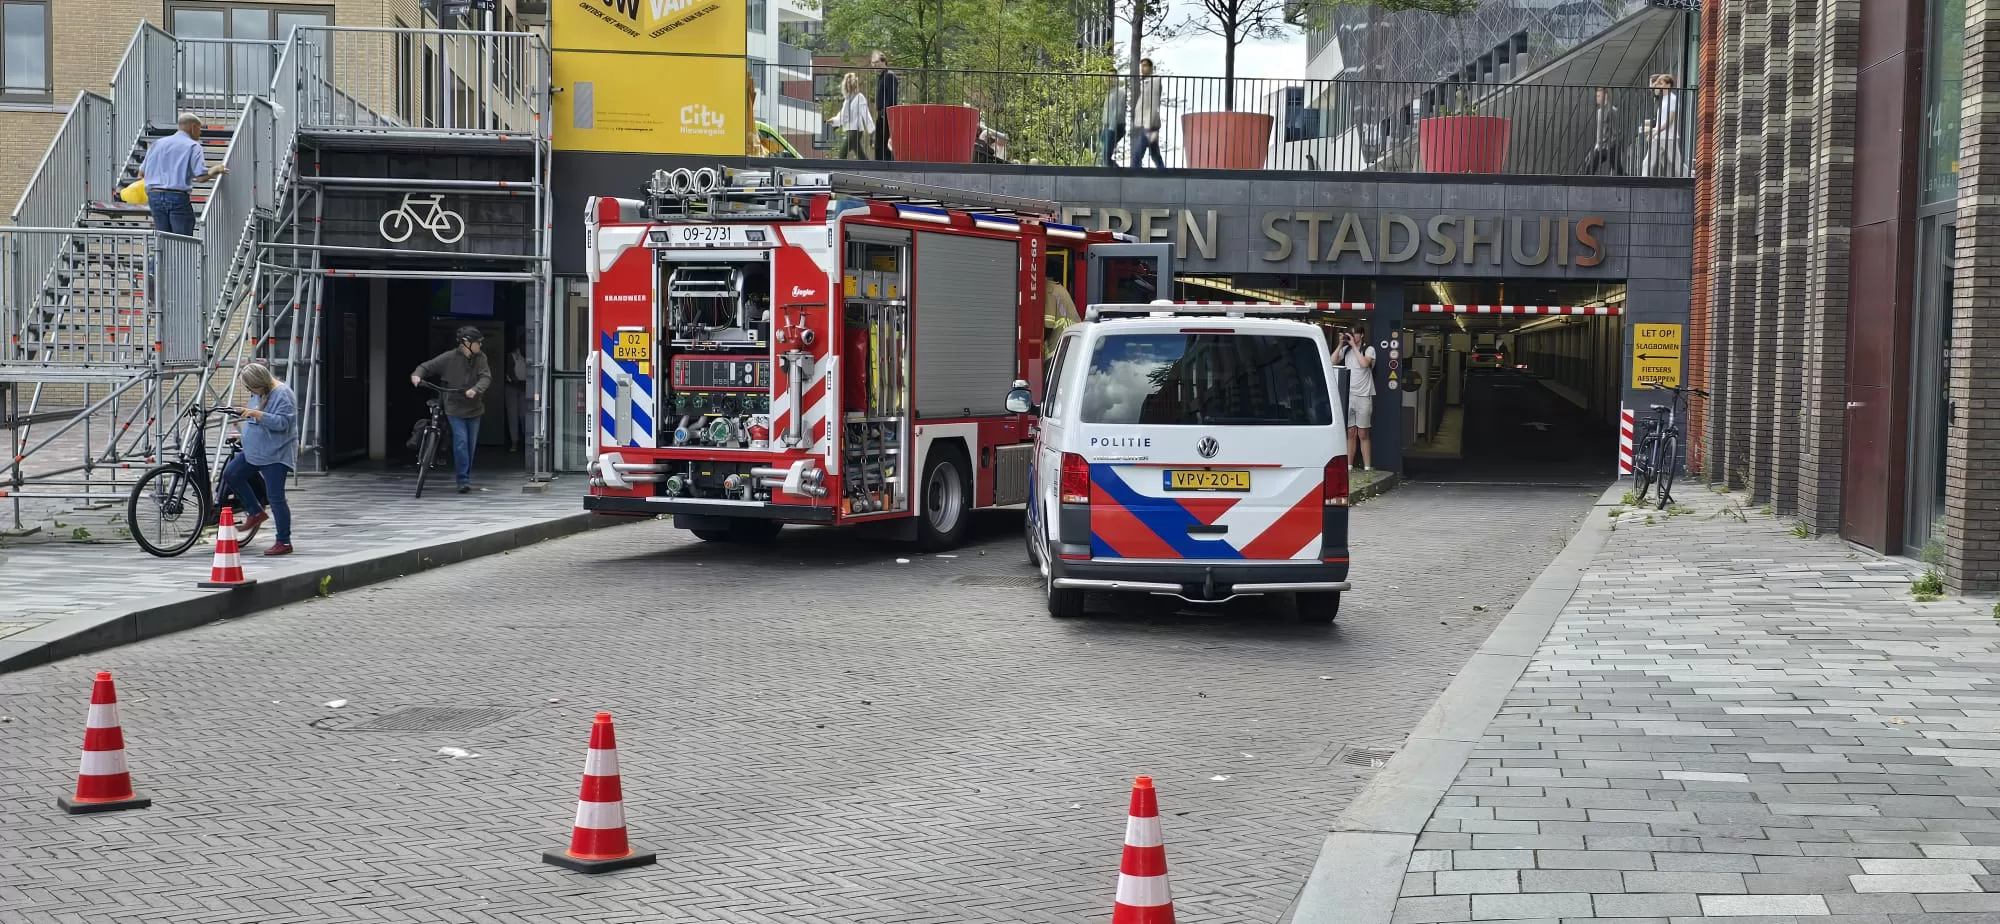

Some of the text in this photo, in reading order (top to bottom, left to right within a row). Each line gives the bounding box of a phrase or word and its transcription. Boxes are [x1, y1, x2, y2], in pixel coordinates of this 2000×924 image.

[680, 103, 725, 128] City
[683, 226, 731, 241] 09-2731
[1261, 210, 1606, 267] STADSHUIS
[604, 294, 647, 302] BRANDWEER
[1641, 328, 1675, 338] LET OP!
[627, 334, 641, 345] 02
[1090, 437, 1151, 447] POLITIE
[1176, 472, 1244, 486] VPV-20-L
